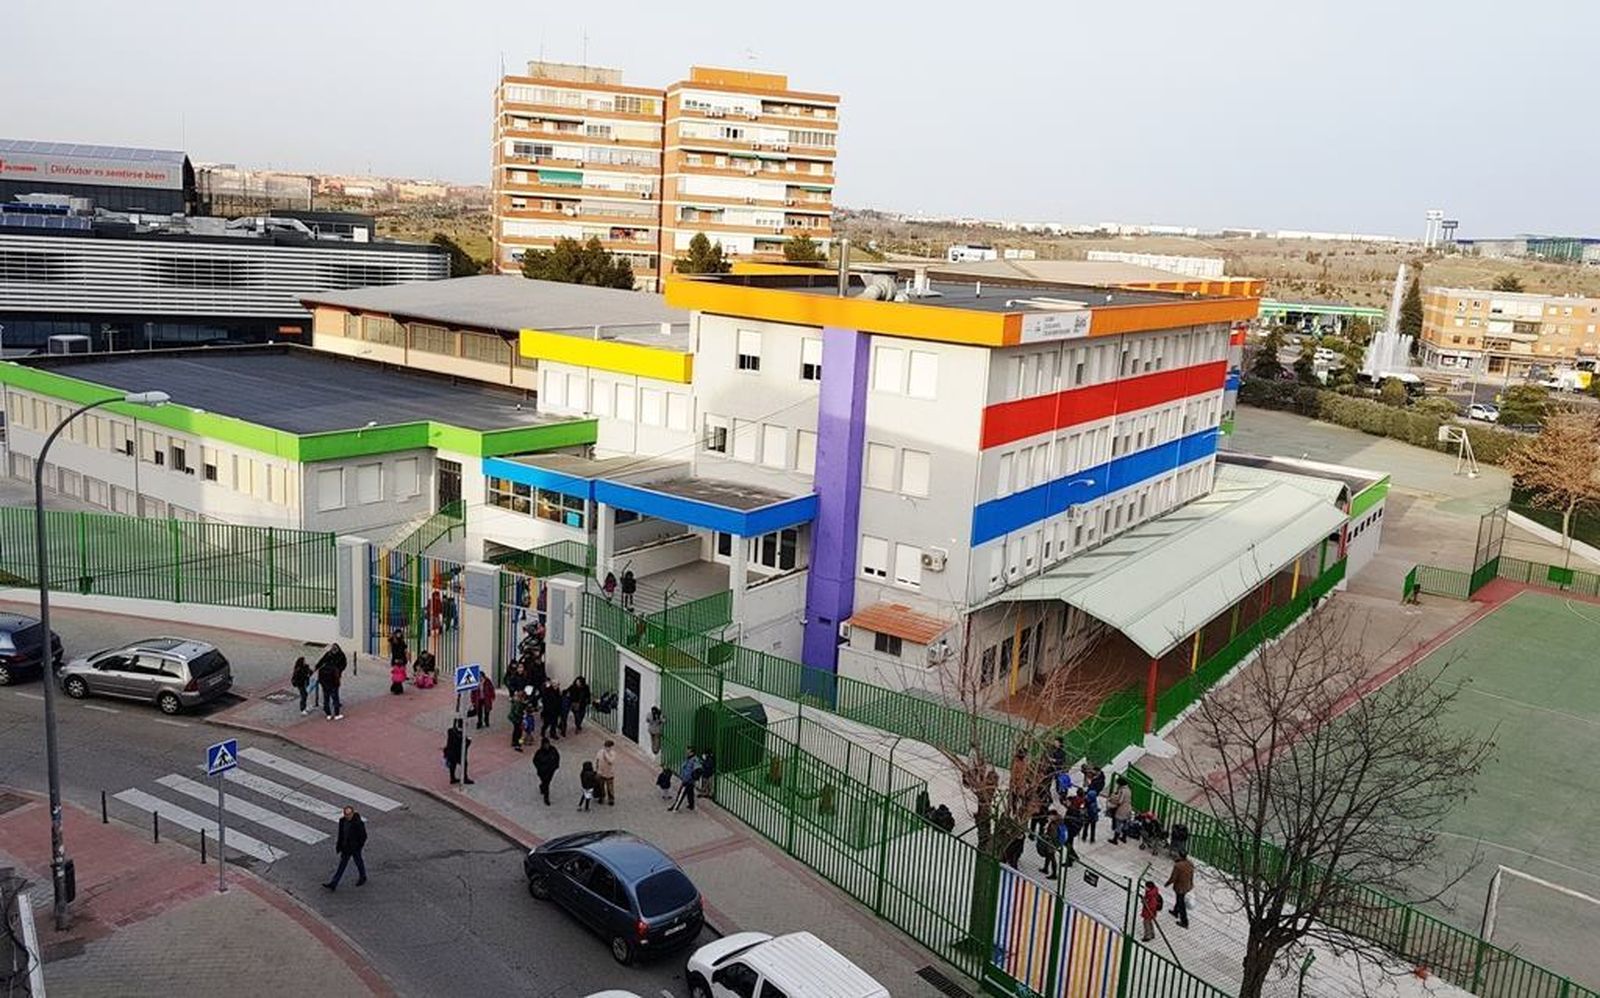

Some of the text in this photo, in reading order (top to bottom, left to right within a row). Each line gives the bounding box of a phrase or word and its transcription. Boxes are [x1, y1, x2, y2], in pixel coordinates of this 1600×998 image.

[51, 163, 166, 180] Disfrutar es sentirse bien
[564, 602, 574, 618] 4
